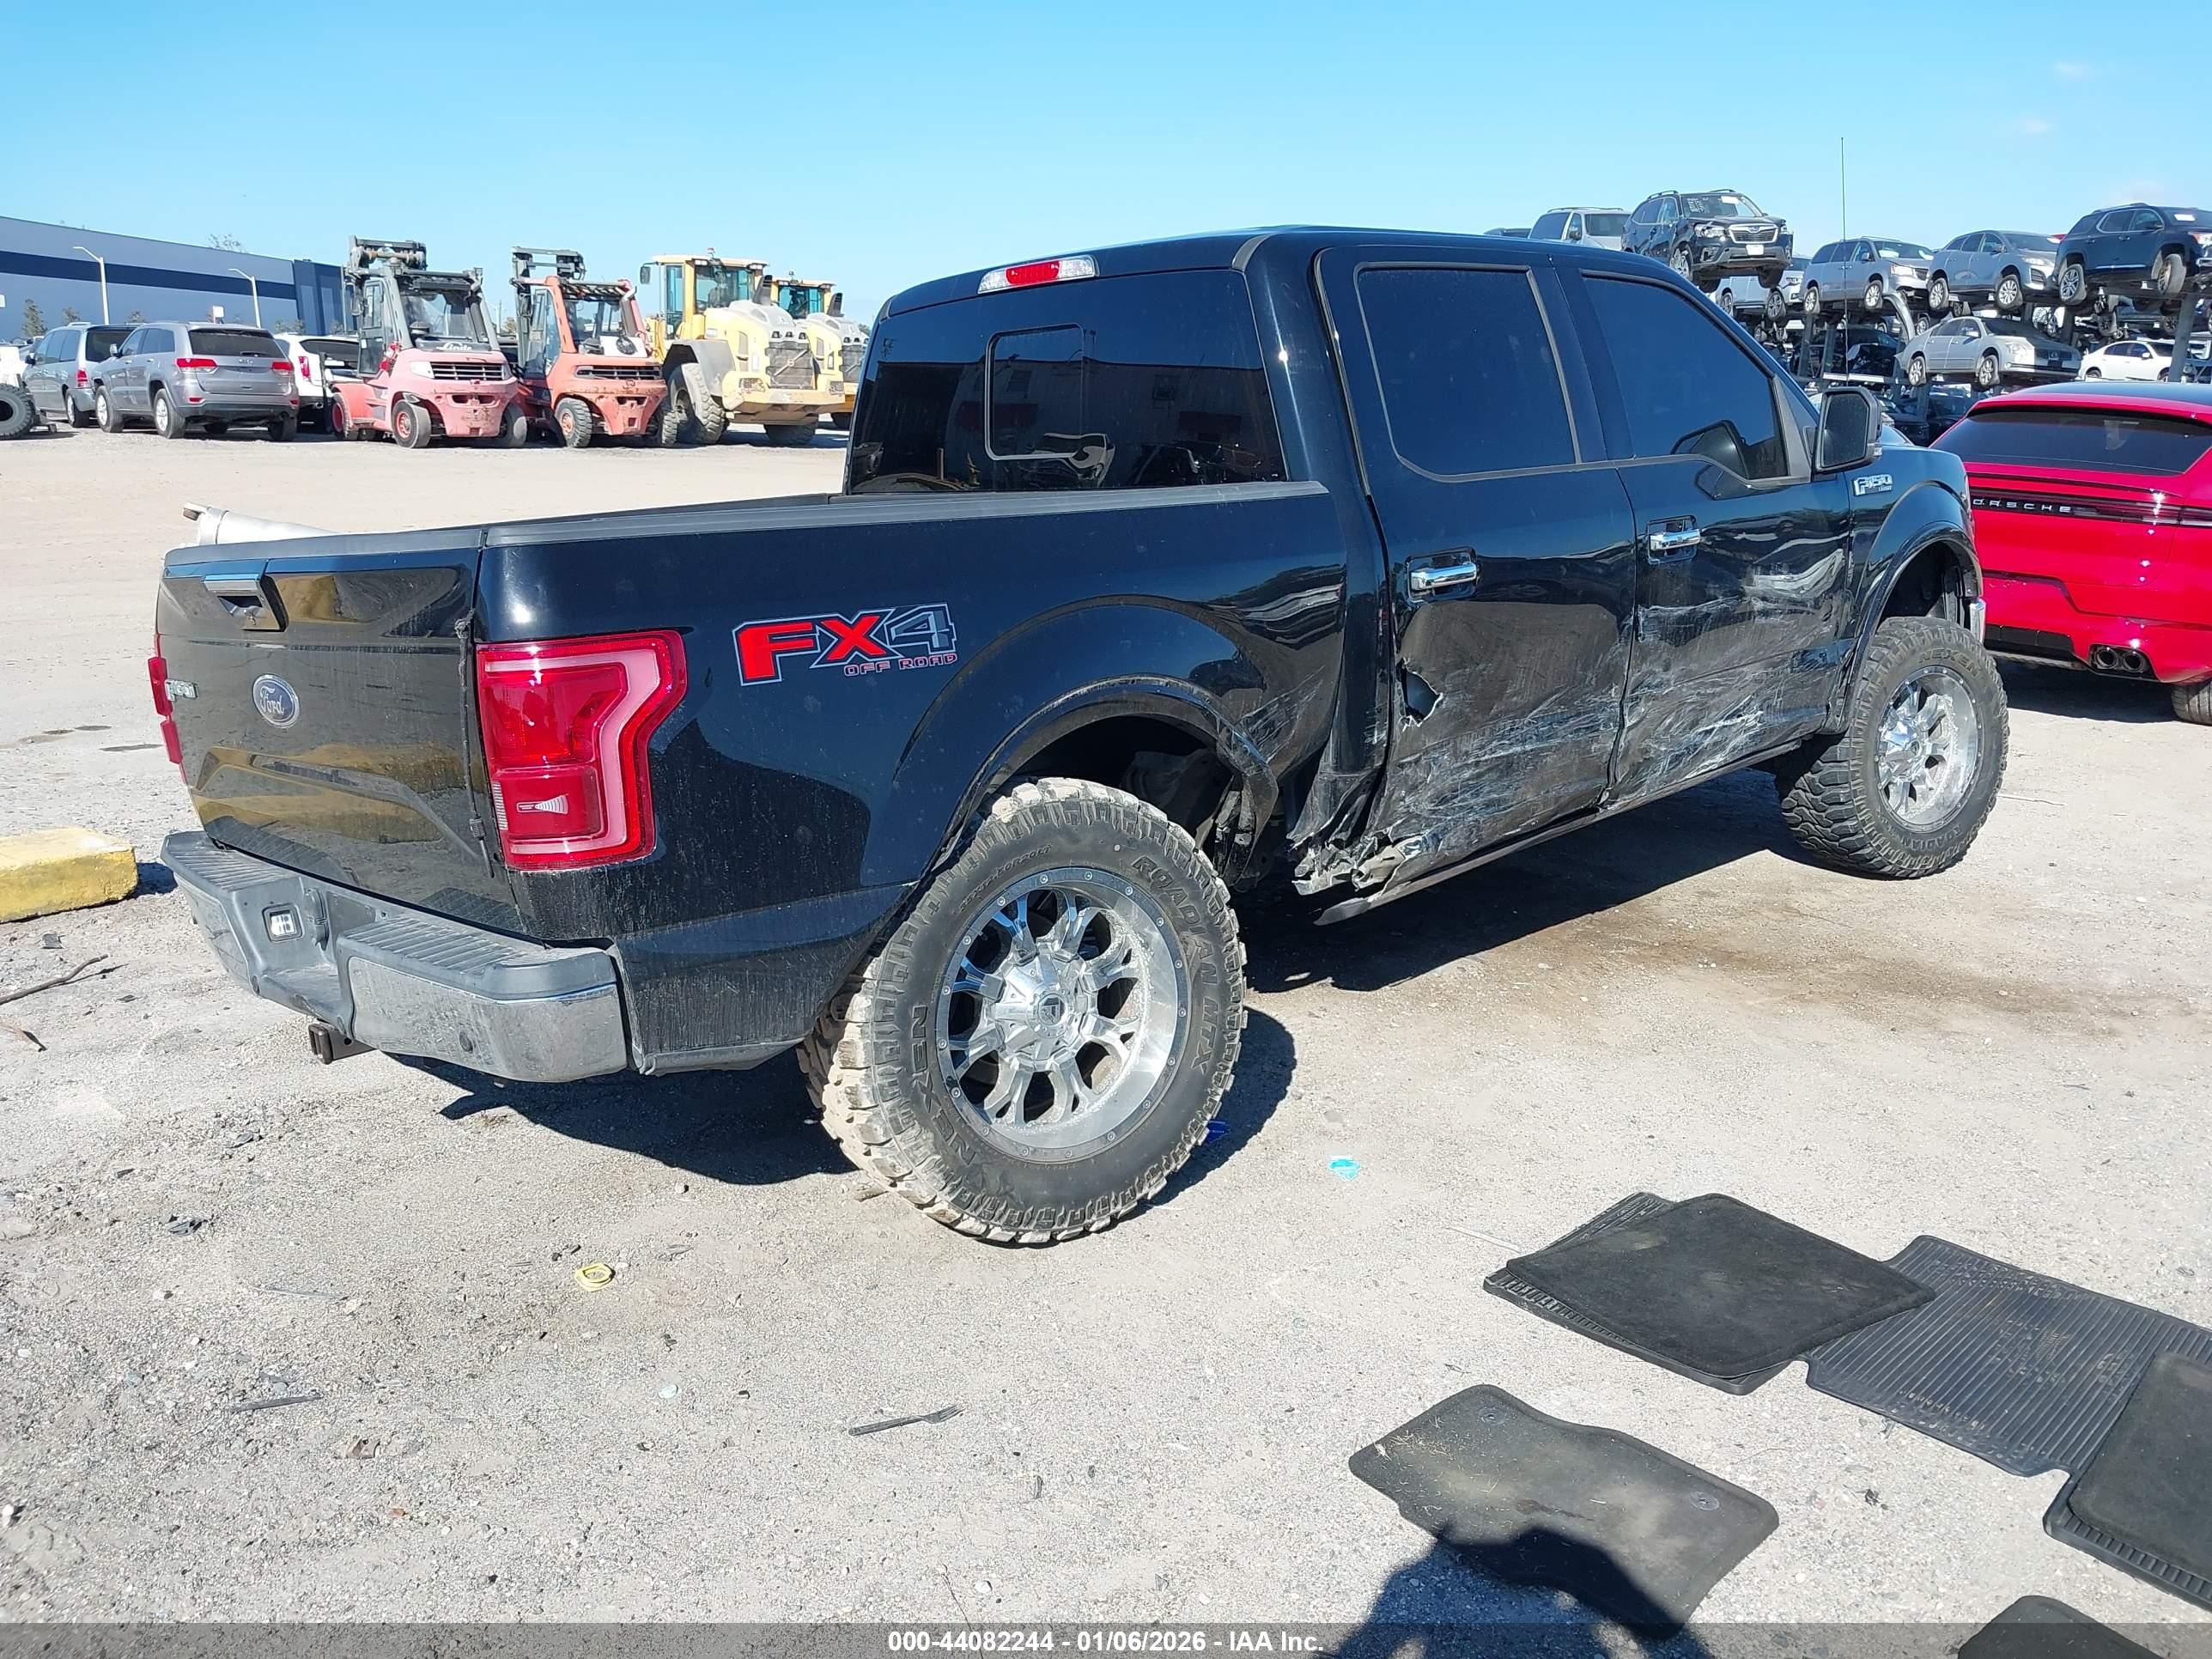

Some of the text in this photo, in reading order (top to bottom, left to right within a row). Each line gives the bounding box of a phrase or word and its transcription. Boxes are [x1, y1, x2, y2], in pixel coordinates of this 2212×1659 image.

[732, 602, 957, 687] FX4
[843, 653, 958, 677] OFF ROAD
[1917, 647, 1980, 678] NEXEN
[259, 685, 285, 714] Ford
[1131, 855, 1219, 1074] ROADIAN MTX
[911, 1005, 976, 1166] NEXEN
